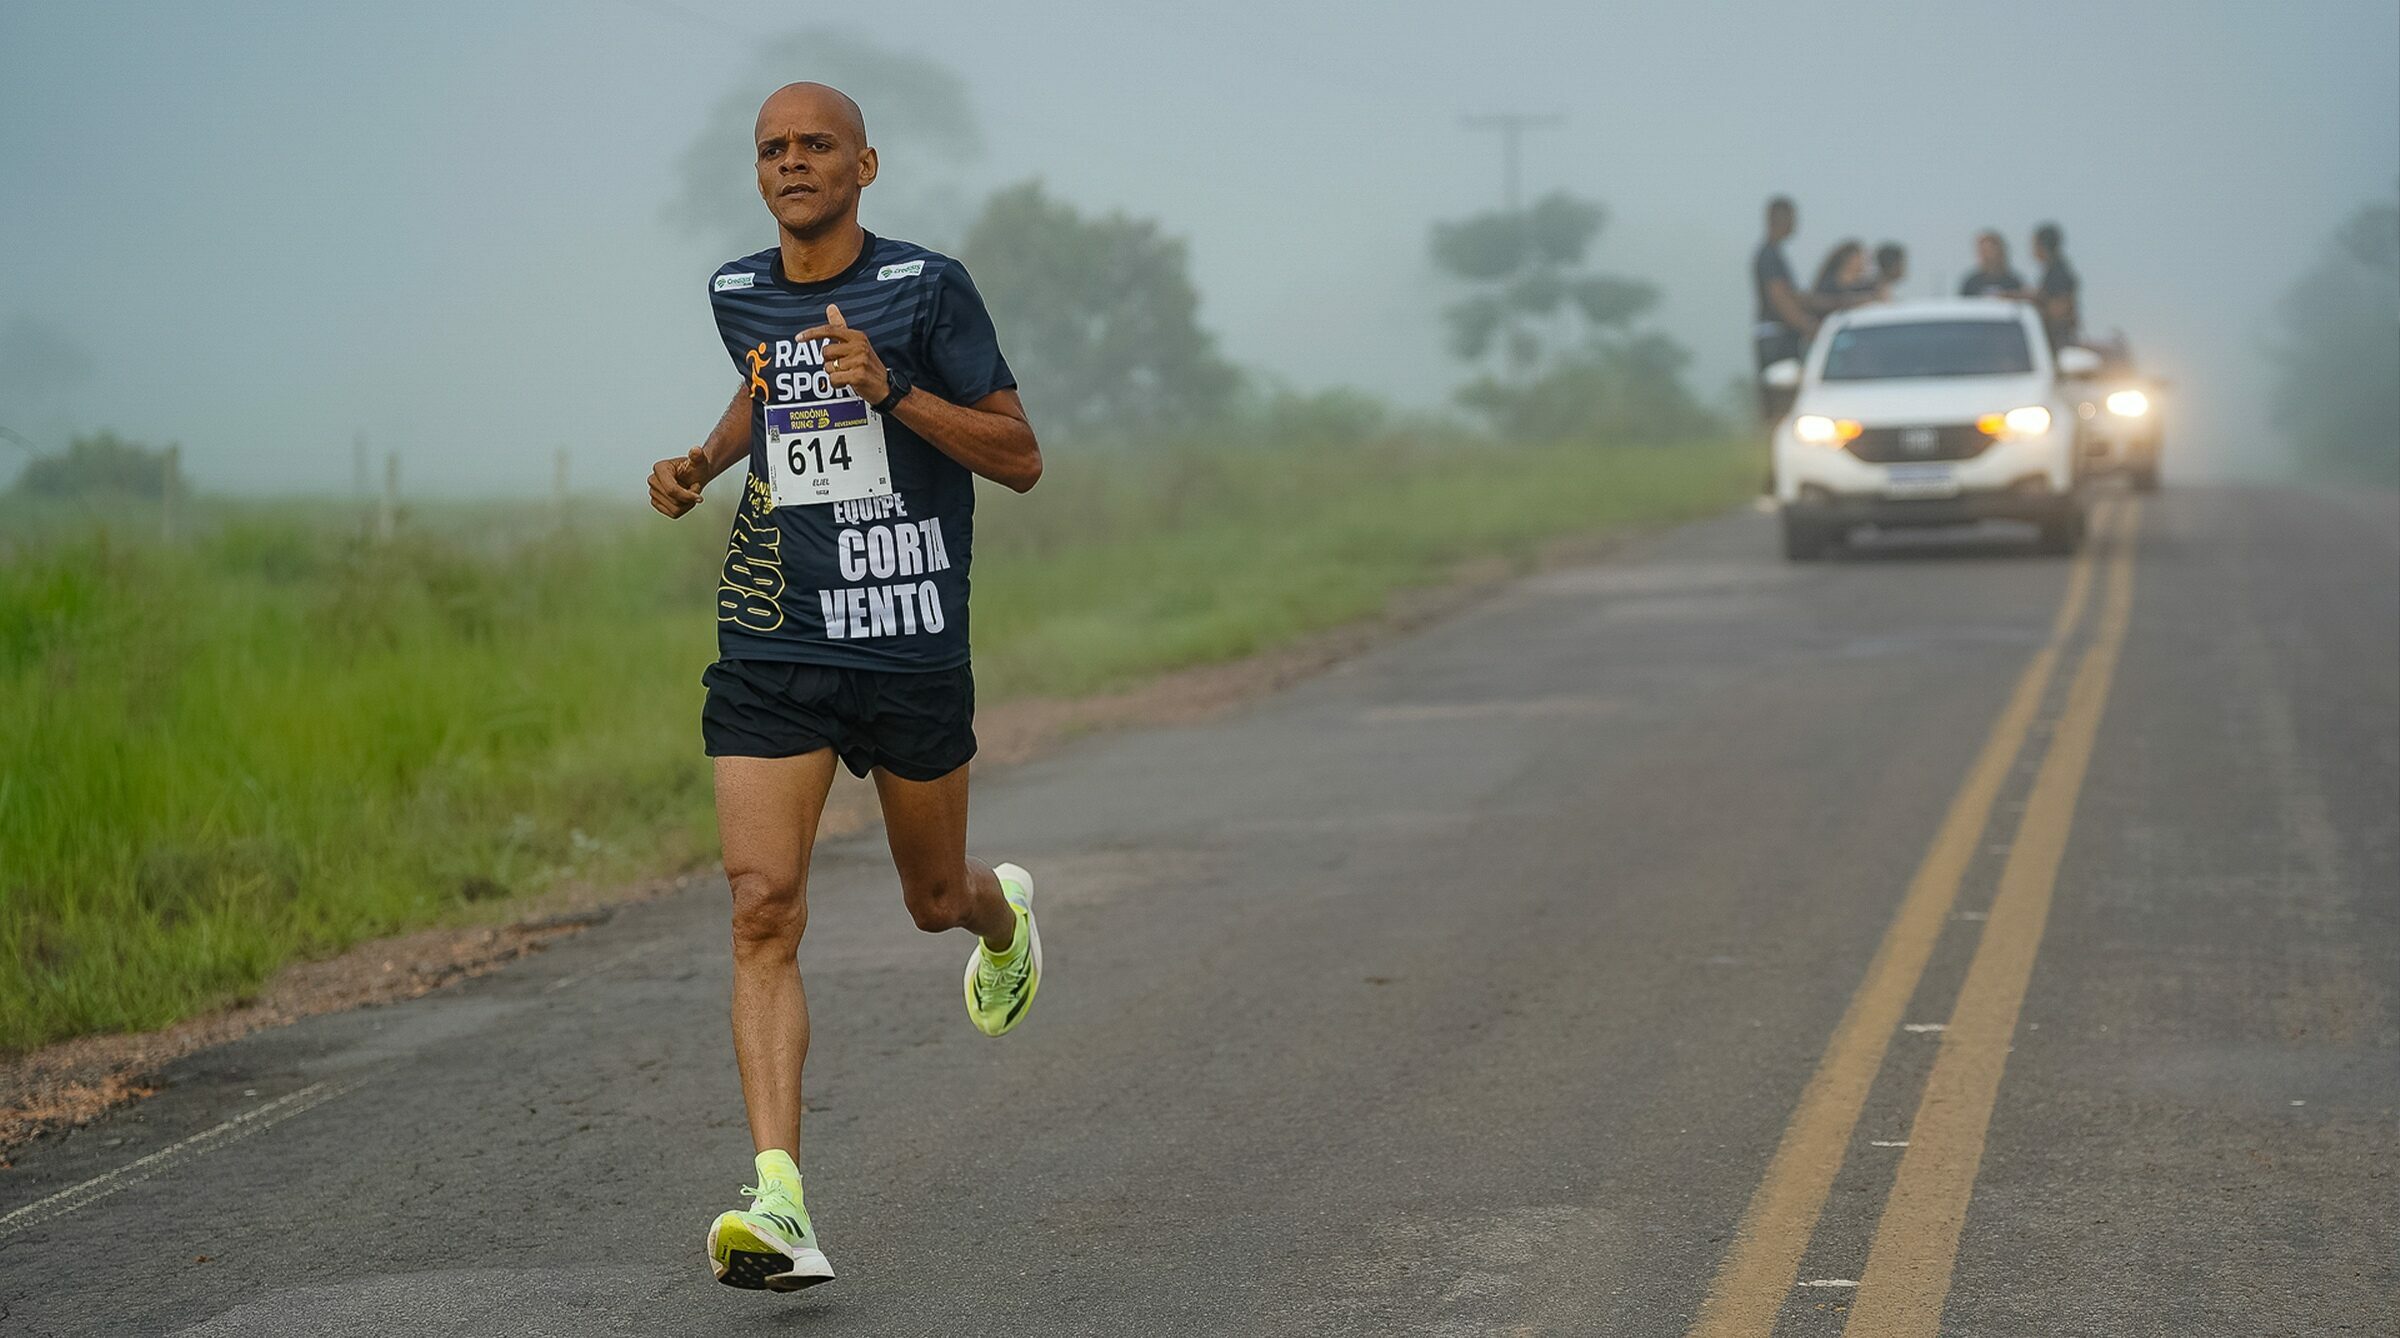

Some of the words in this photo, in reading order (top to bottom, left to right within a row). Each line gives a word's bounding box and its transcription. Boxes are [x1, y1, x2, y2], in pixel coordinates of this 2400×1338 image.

[787, 434, 853, 476] 614
[833, 492, 908, 525] EQUIPE
[838, 516, 951, 582] CORTA
[818, 579, 945, 639] VENTO
